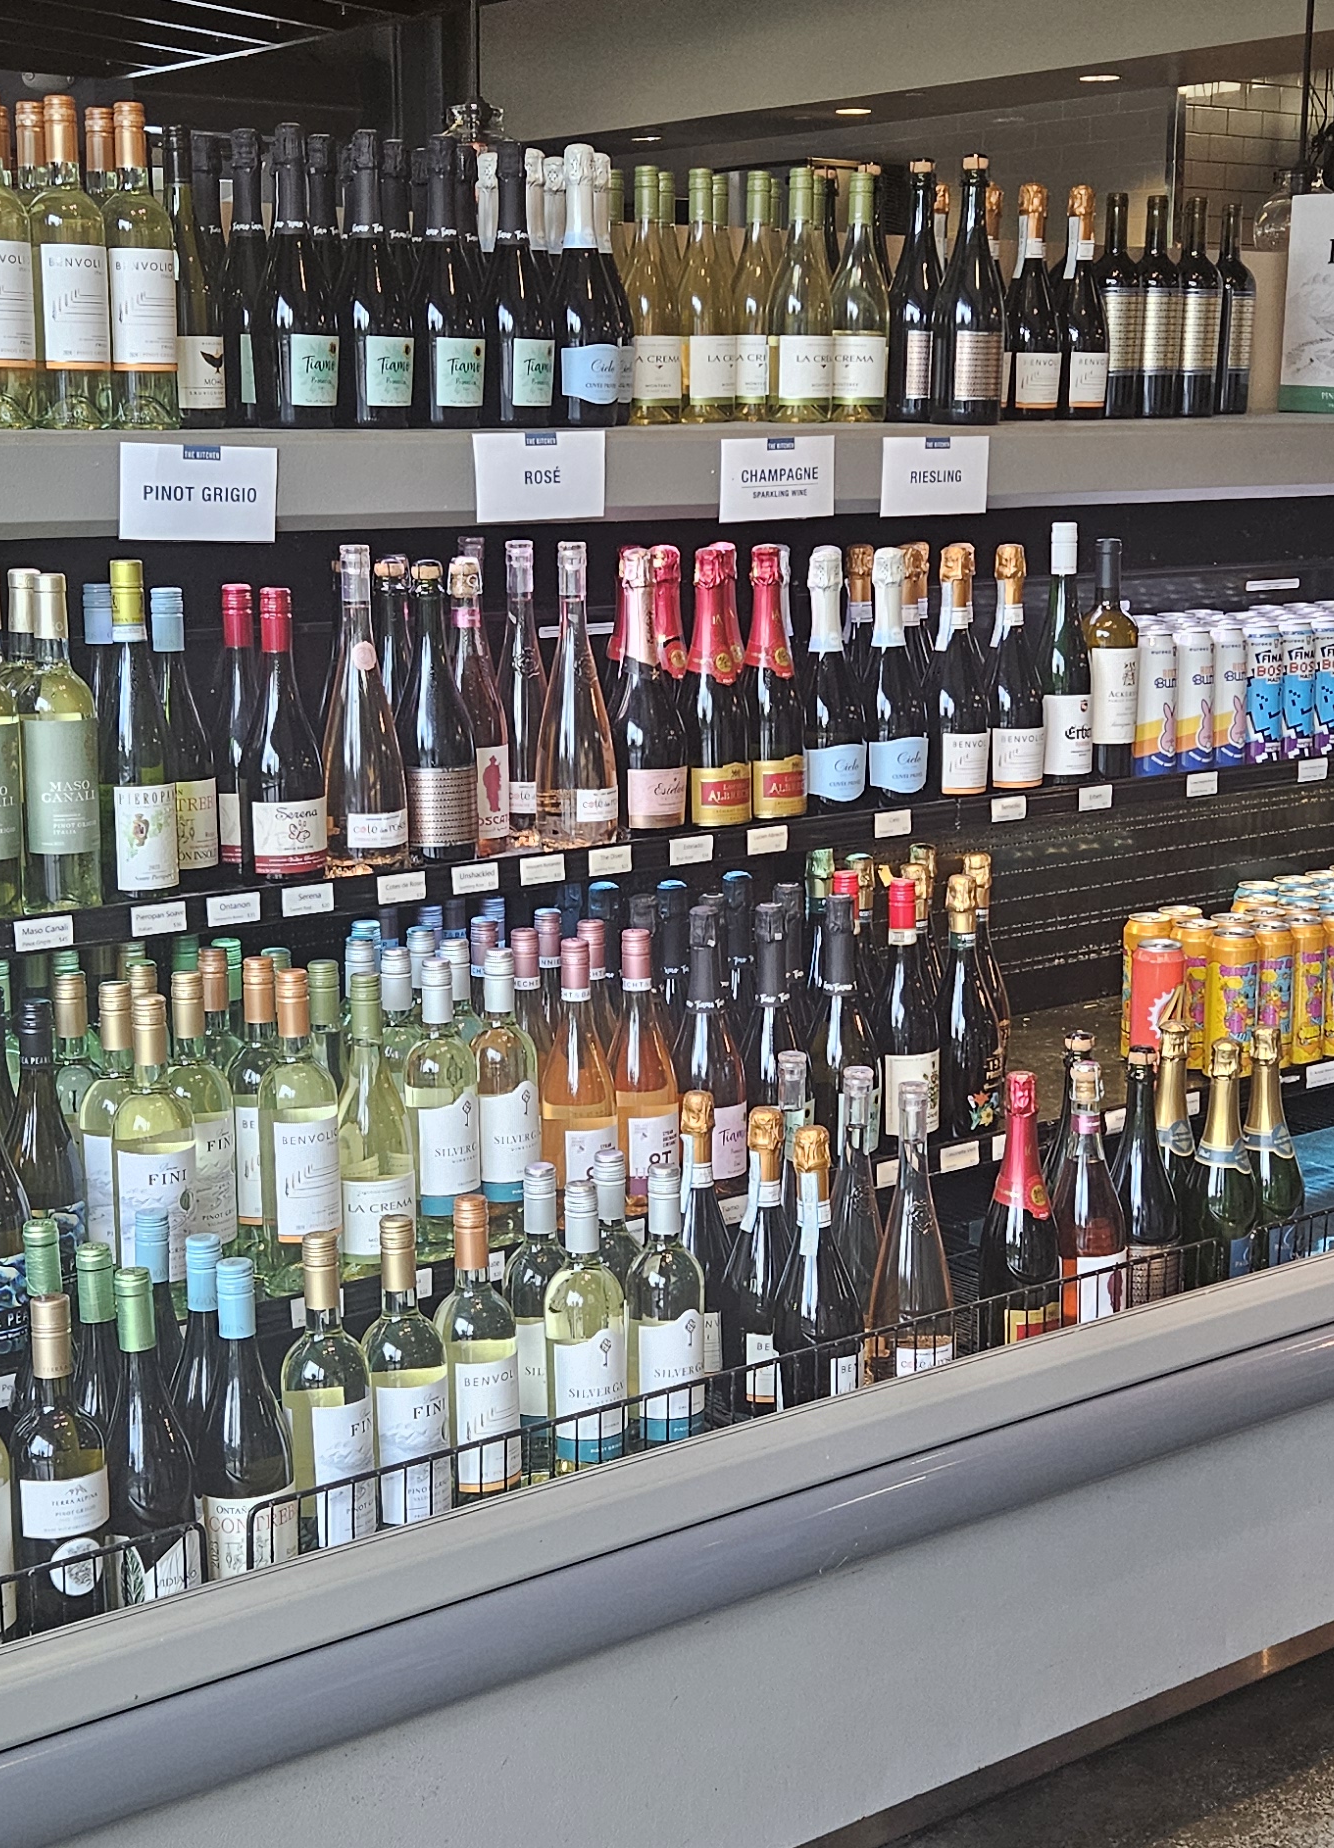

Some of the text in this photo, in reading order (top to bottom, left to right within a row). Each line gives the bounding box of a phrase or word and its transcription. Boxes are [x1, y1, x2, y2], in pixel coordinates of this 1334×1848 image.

[834, 354, 874, 363] CREMA
[537, 437, 556, 445] KITCHEN
[184, 450, 220, 459] THE KITCHEN
[525, 467, 560, 485] ROSÉ
[741, 466, 818, 483] CHAMPAGNE
[910, 470, 962, 484] RIESLING
[144, 486, 257, 503] PINOT GRIGIO
[752, 489, 807, 499] SPARKLING WINE
[897, 751, 921, 765] Cielo
[834, 759, 859, 772] Cielo
[49, 780, 91, 792] MASO
[41, 790, 95, 803] CANALI
[276, 806, 317, 821] Serena
[459, 869, 495, 881] Unshackled
[298, 892, 322, 901] Serena
[219, 901, 250, 911] Ontanon
[136, 909, 184, 922] Pieropan Soave
[22, 925, 67, 936] Maso Canali
[148, 1168, 187, 1186] FINI
[348, 1196, 412, 1213] LA CREMA
